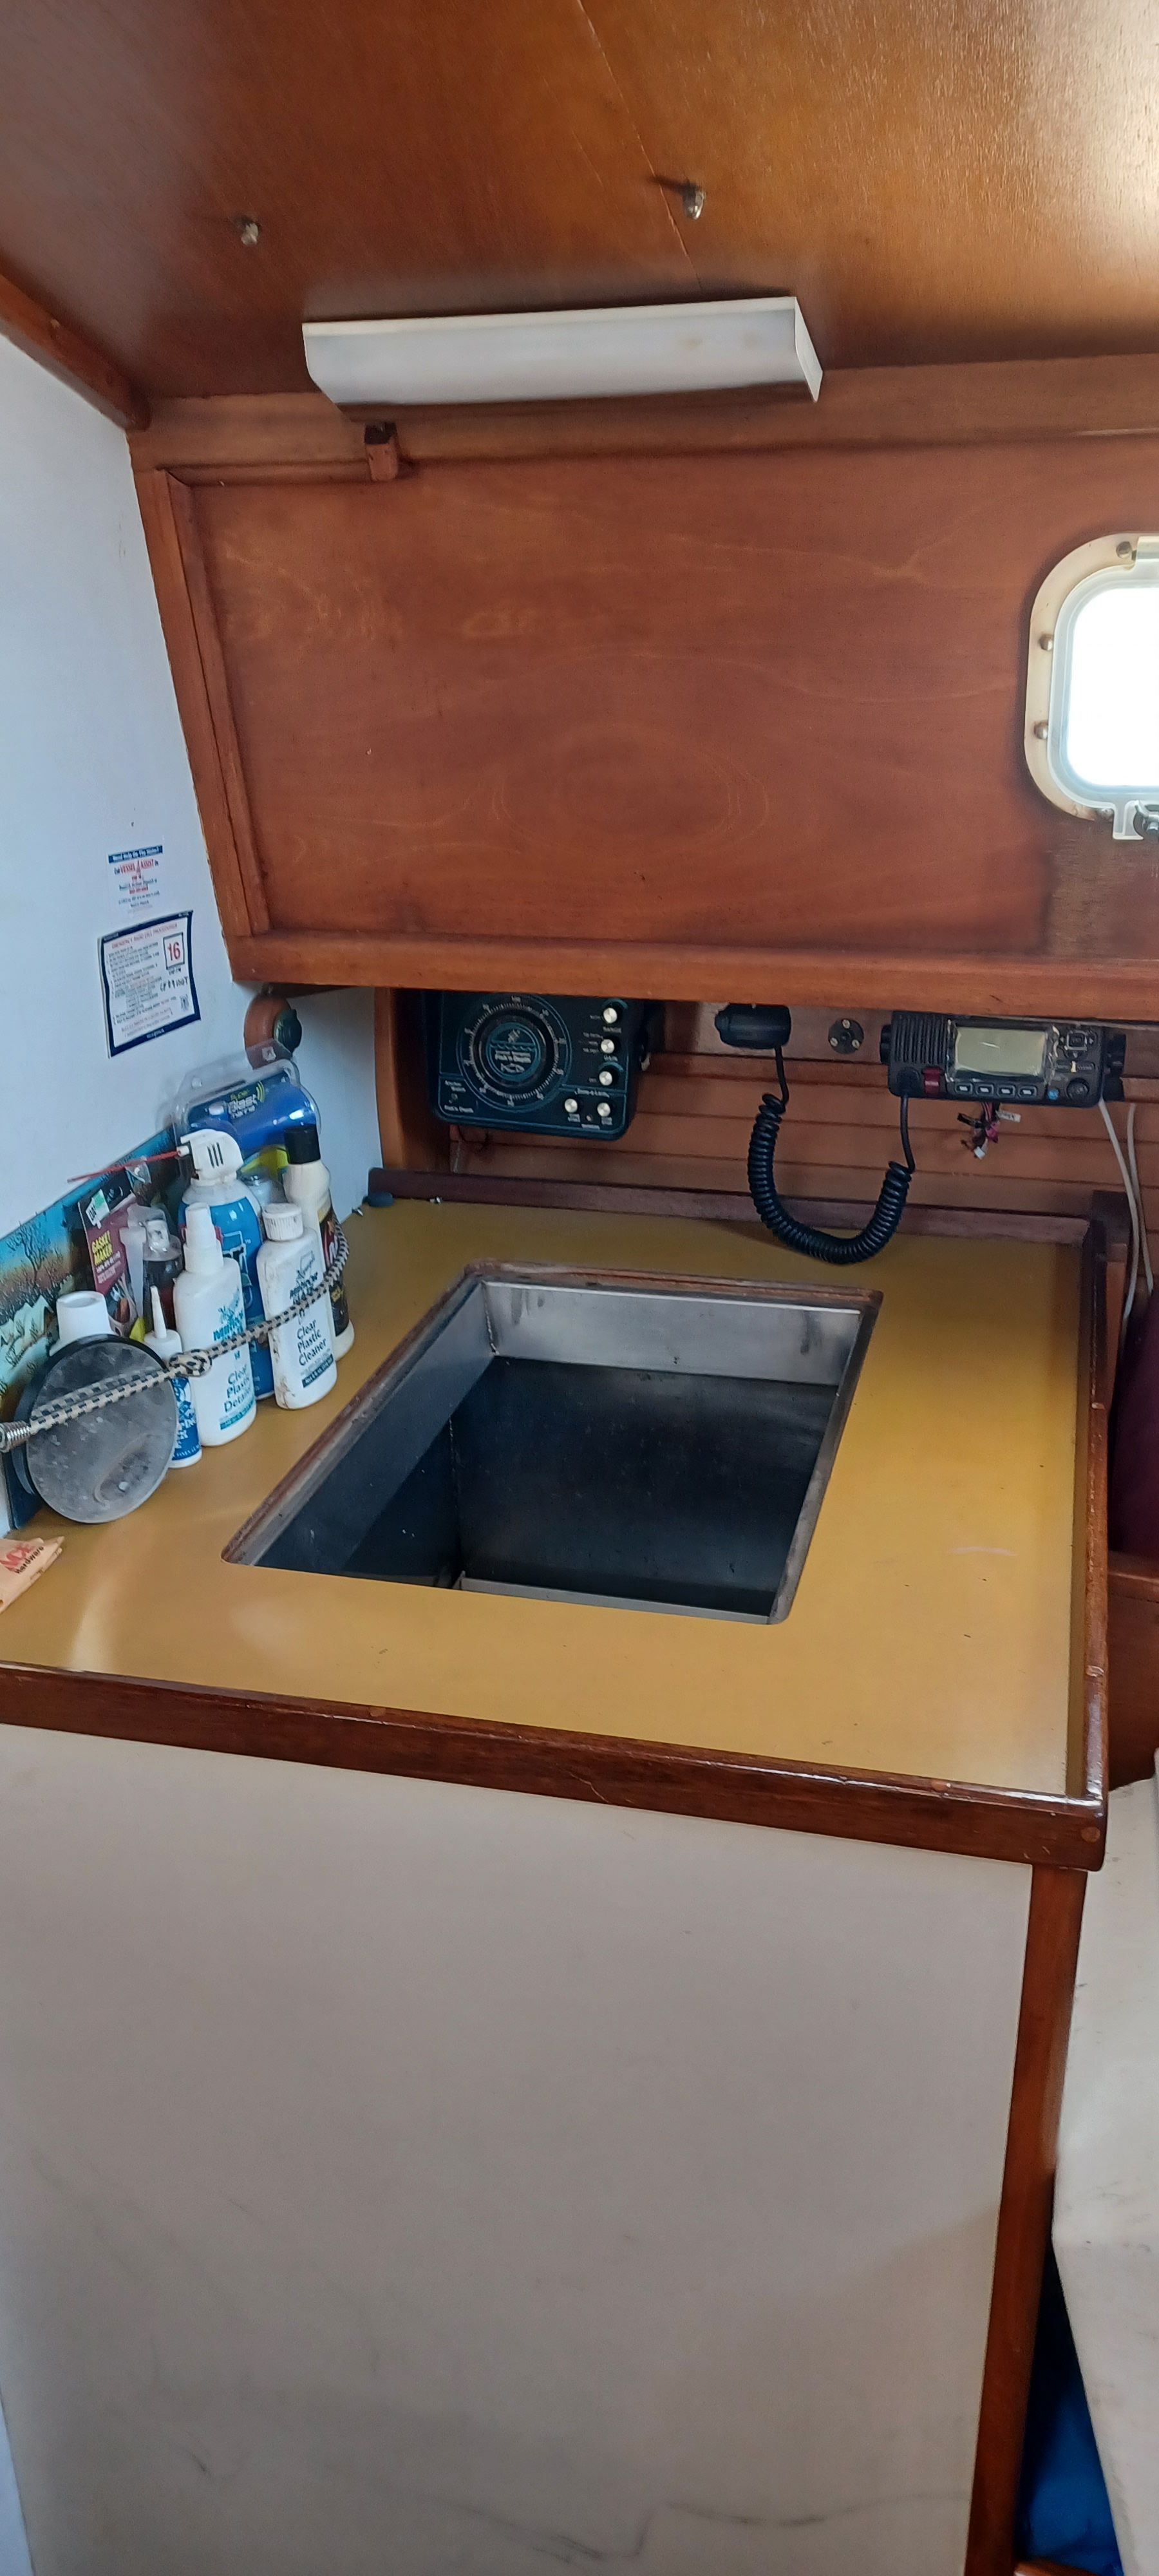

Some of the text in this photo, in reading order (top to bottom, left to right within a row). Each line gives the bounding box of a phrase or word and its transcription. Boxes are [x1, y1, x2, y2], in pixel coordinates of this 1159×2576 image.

[167, 942, 181, 961] 16
[92, 1230, 111, 1254] GASKET
[94, 1244, 113, 1266] MAKER
[297, 1319, 317, 1340] Clear
[297, 1329, 321, 1354] Plastic
[298, 1338, 327, 1367] Cleaner
[14, 1546, 44, 1574] Hardware
